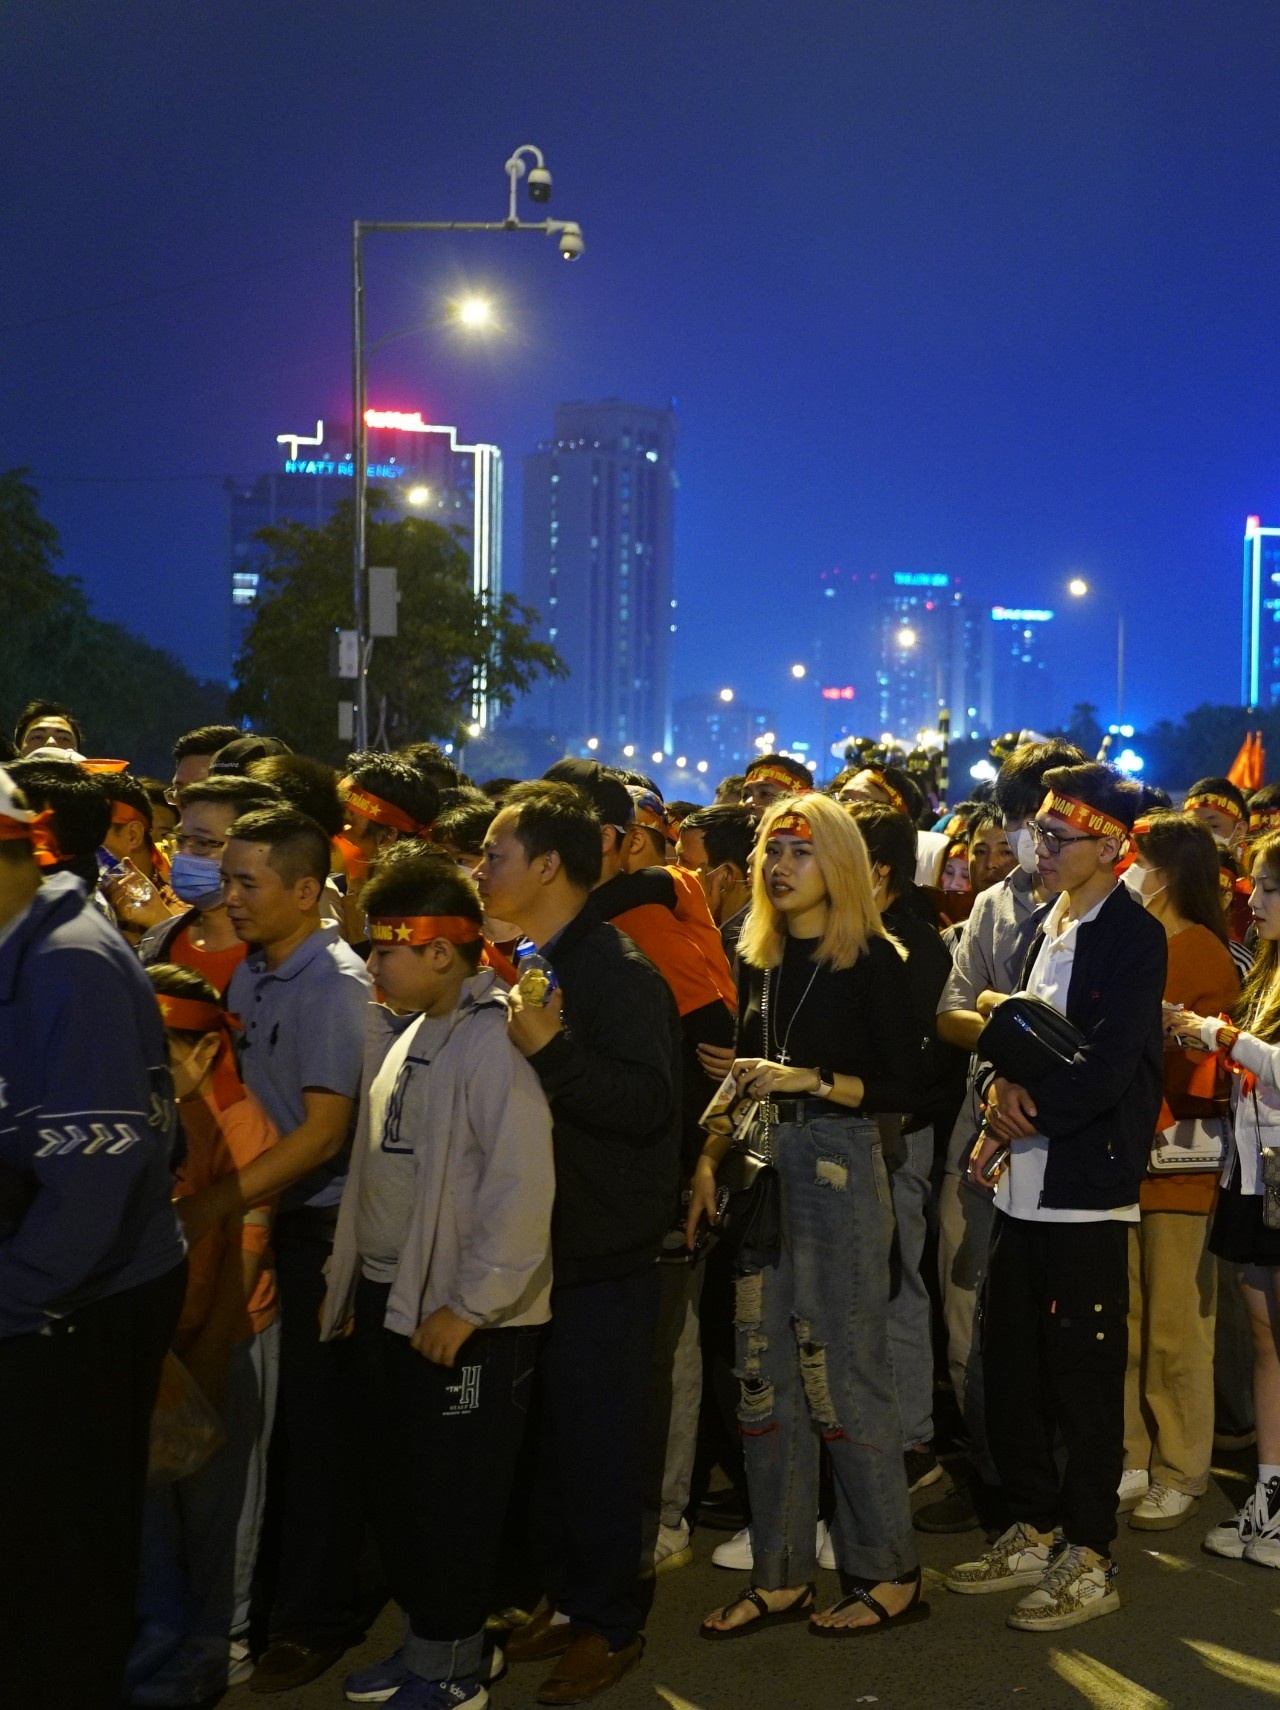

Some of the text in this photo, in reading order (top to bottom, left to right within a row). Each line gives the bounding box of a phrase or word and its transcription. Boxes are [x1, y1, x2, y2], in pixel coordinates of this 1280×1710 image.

[285, 460, 404, 479] HYATT REENCY
[1052, 796, 1076, 817] NAM
[1088, 814, 1104, 831] VÔ
